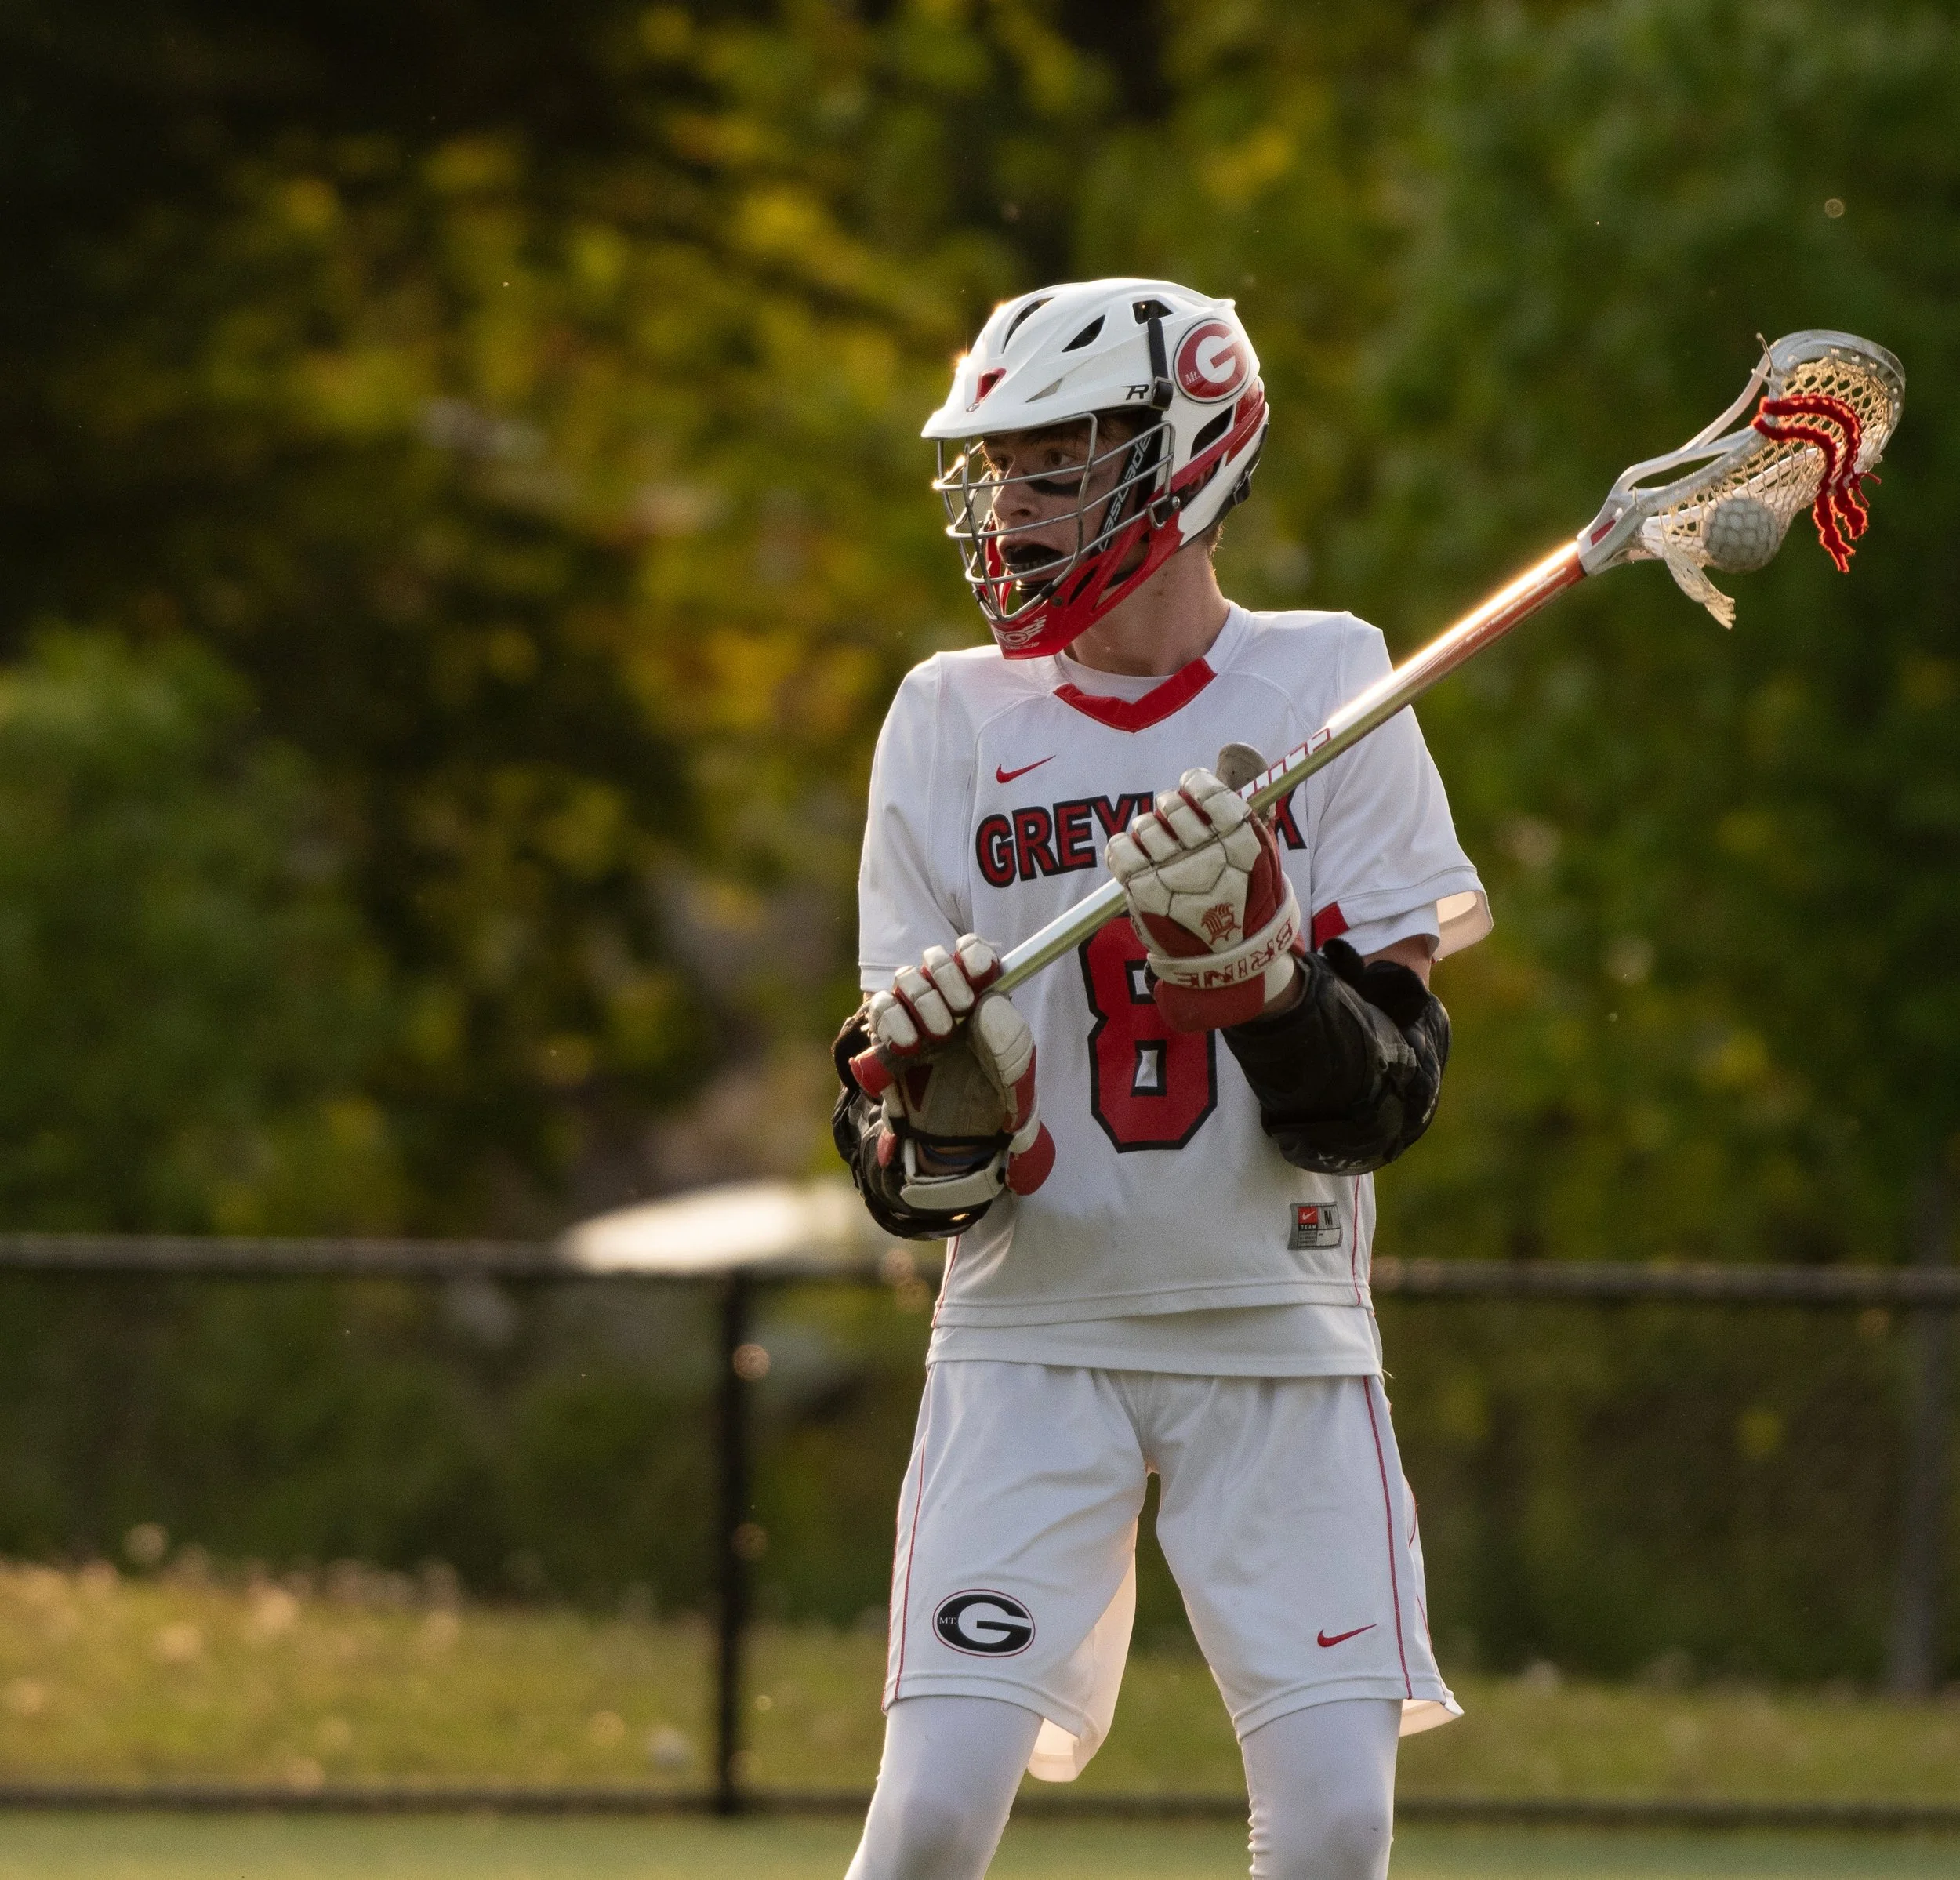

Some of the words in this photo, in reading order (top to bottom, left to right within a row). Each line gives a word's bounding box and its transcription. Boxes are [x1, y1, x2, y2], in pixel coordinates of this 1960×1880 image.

[1178, 323, 1248, 398] G
[1237, 727, 1332, 801] CLUT
[975, 790, 1307, 887] GREYK
[1174, 916, 1294, 988] BRINE
[1078, 914, 1218, 1152] 8
[1323, 1210, 1334, 1225] M
[936, 1594, 1033, 1653] G
